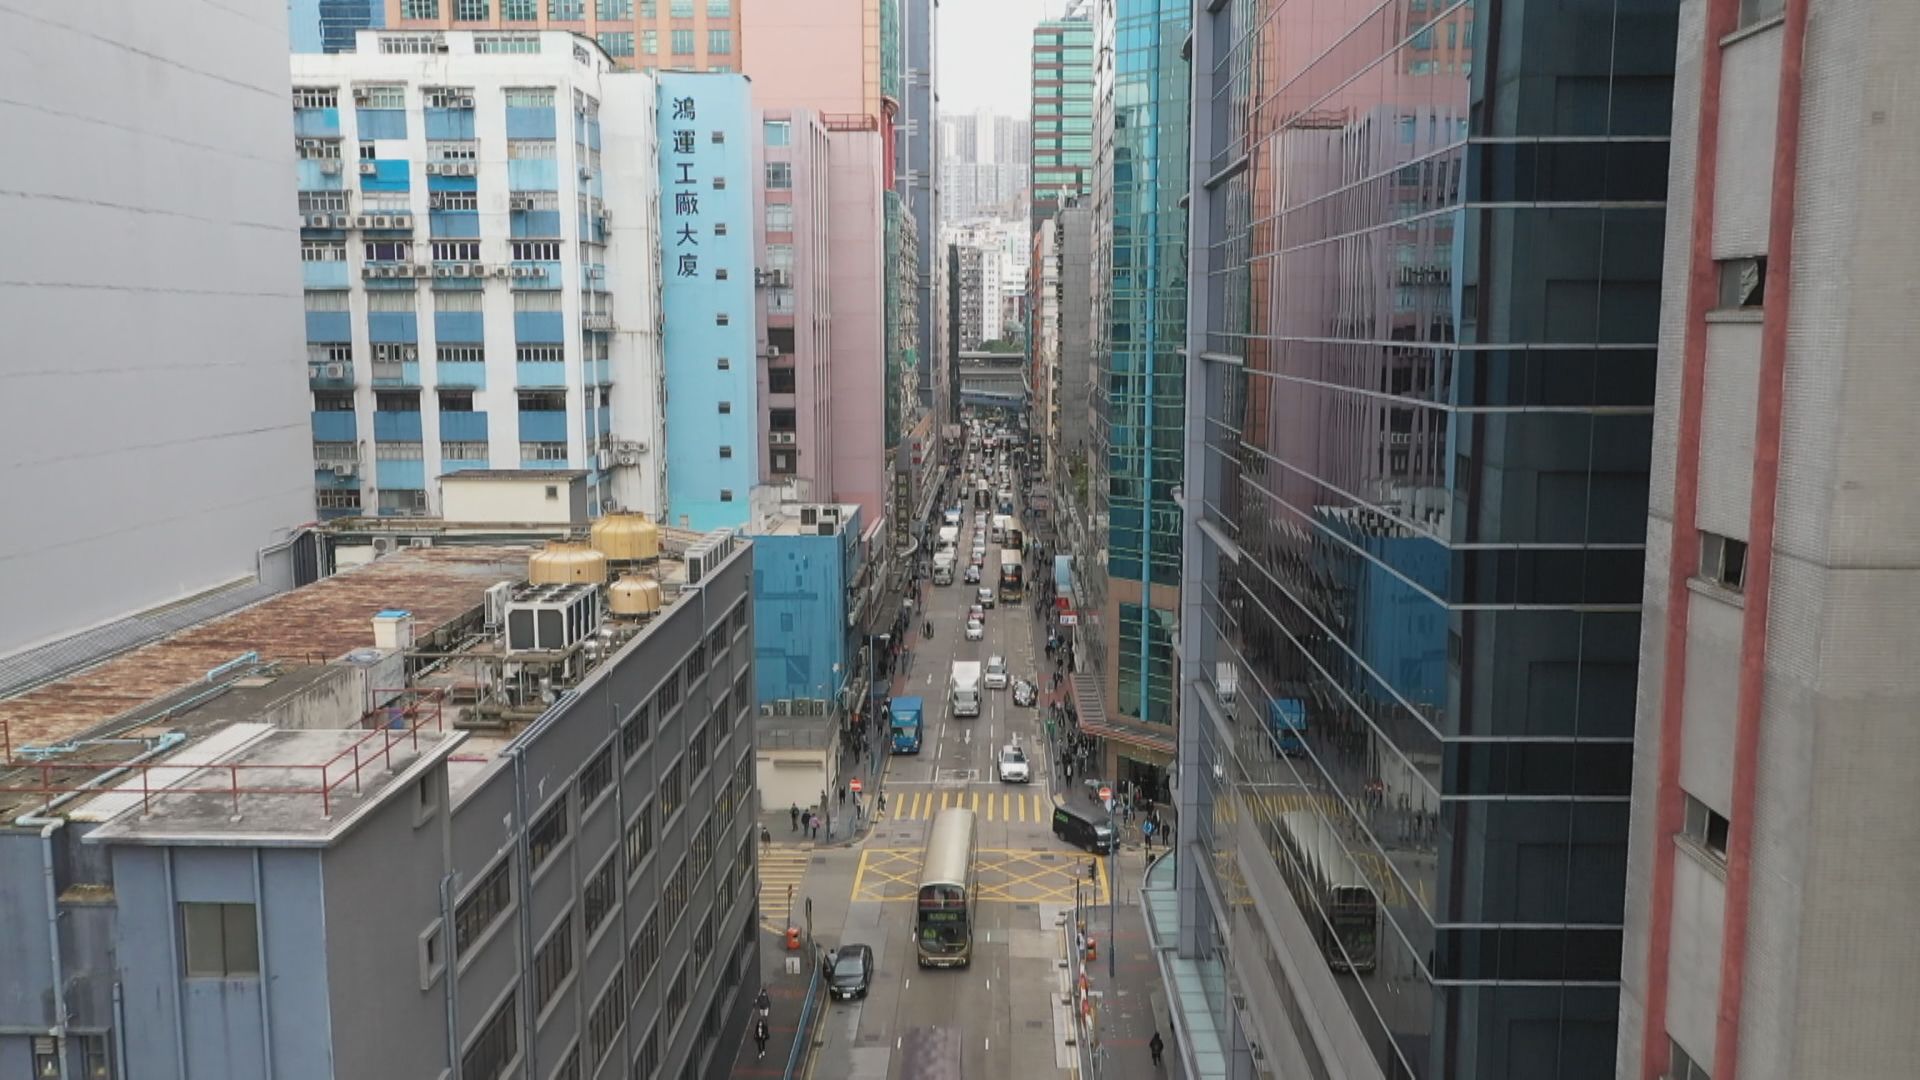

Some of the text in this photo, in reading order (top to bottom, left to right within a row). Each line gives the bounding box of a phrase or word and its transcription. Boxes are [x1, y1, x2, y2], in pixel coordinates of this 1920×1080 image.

[672, 96, 699, 277] 鴻運工廠大廈
